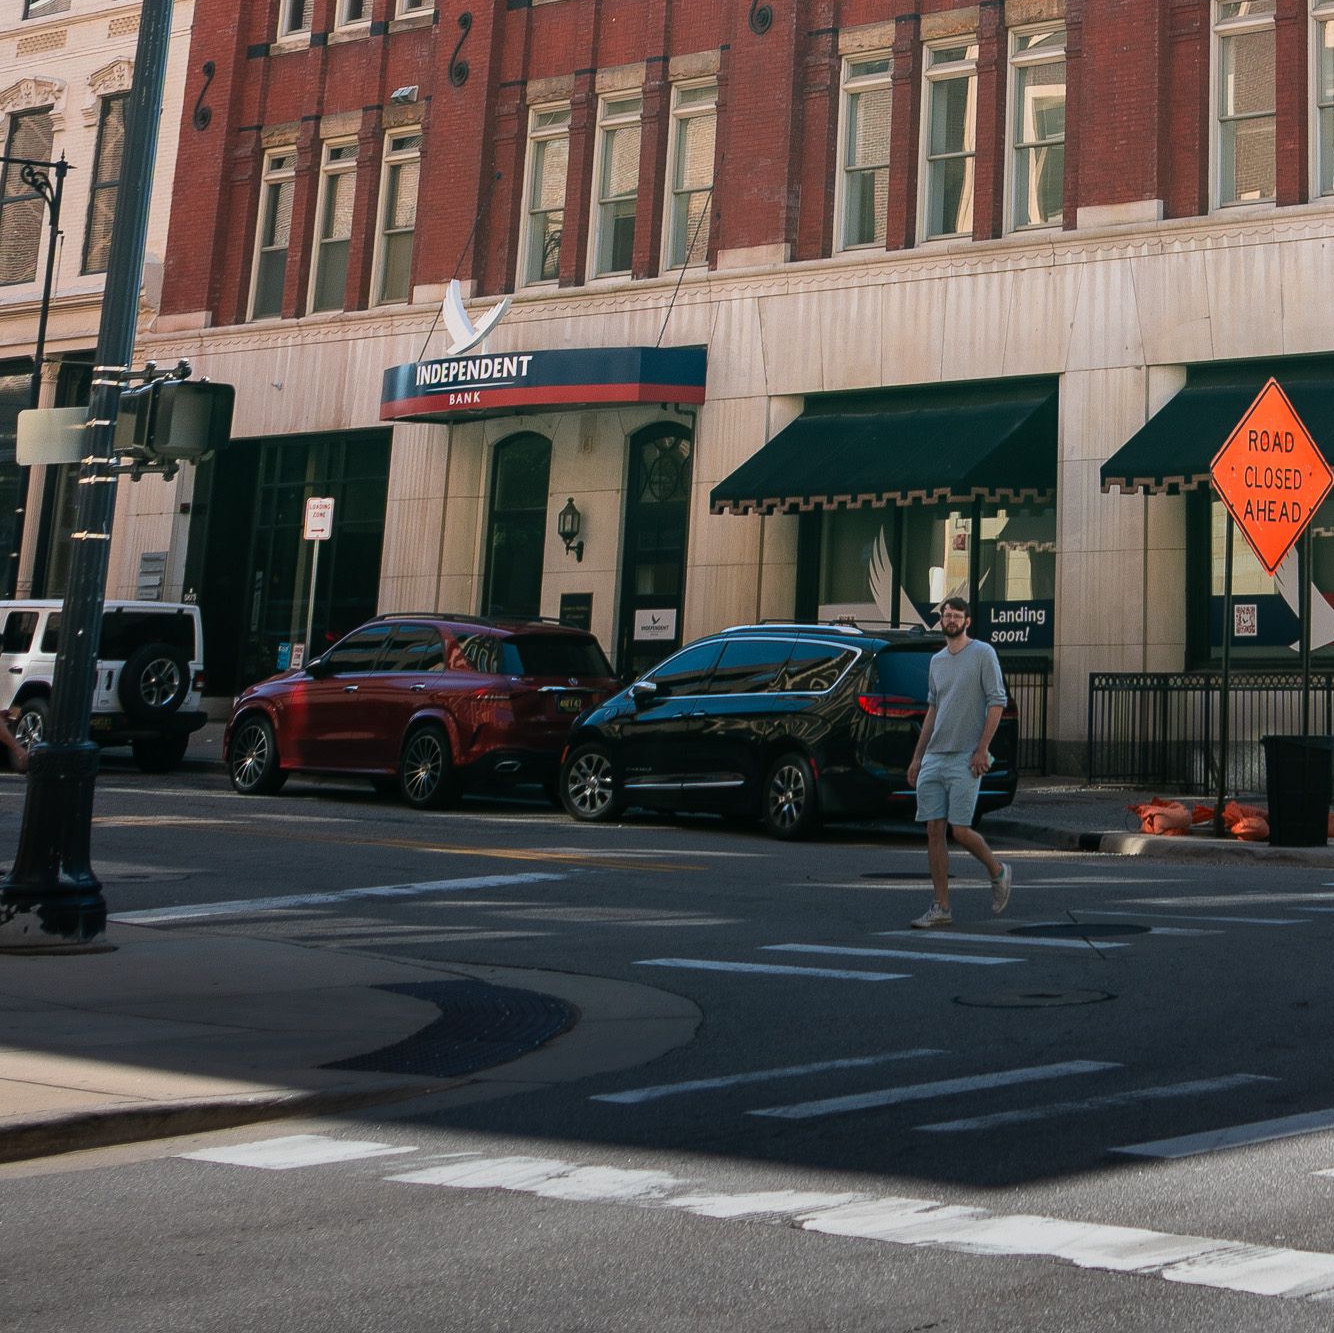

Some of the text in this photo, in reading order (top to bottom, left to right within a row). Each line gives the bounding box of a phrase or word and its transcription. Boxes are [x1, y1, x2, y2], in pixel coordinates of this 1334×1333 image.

[416, 355, 533, 386] INDEPENDENT
[449, 391, 481, 406] BANK
[1248, 430, 1295, 453] ROAD
[1244, 466, 1303, 490] CLOSED
[1243, 499, 1301, 523] AHEAD
[991, 606, 1046, 625] Landing
[990, 626, 1029, 643] soon!
